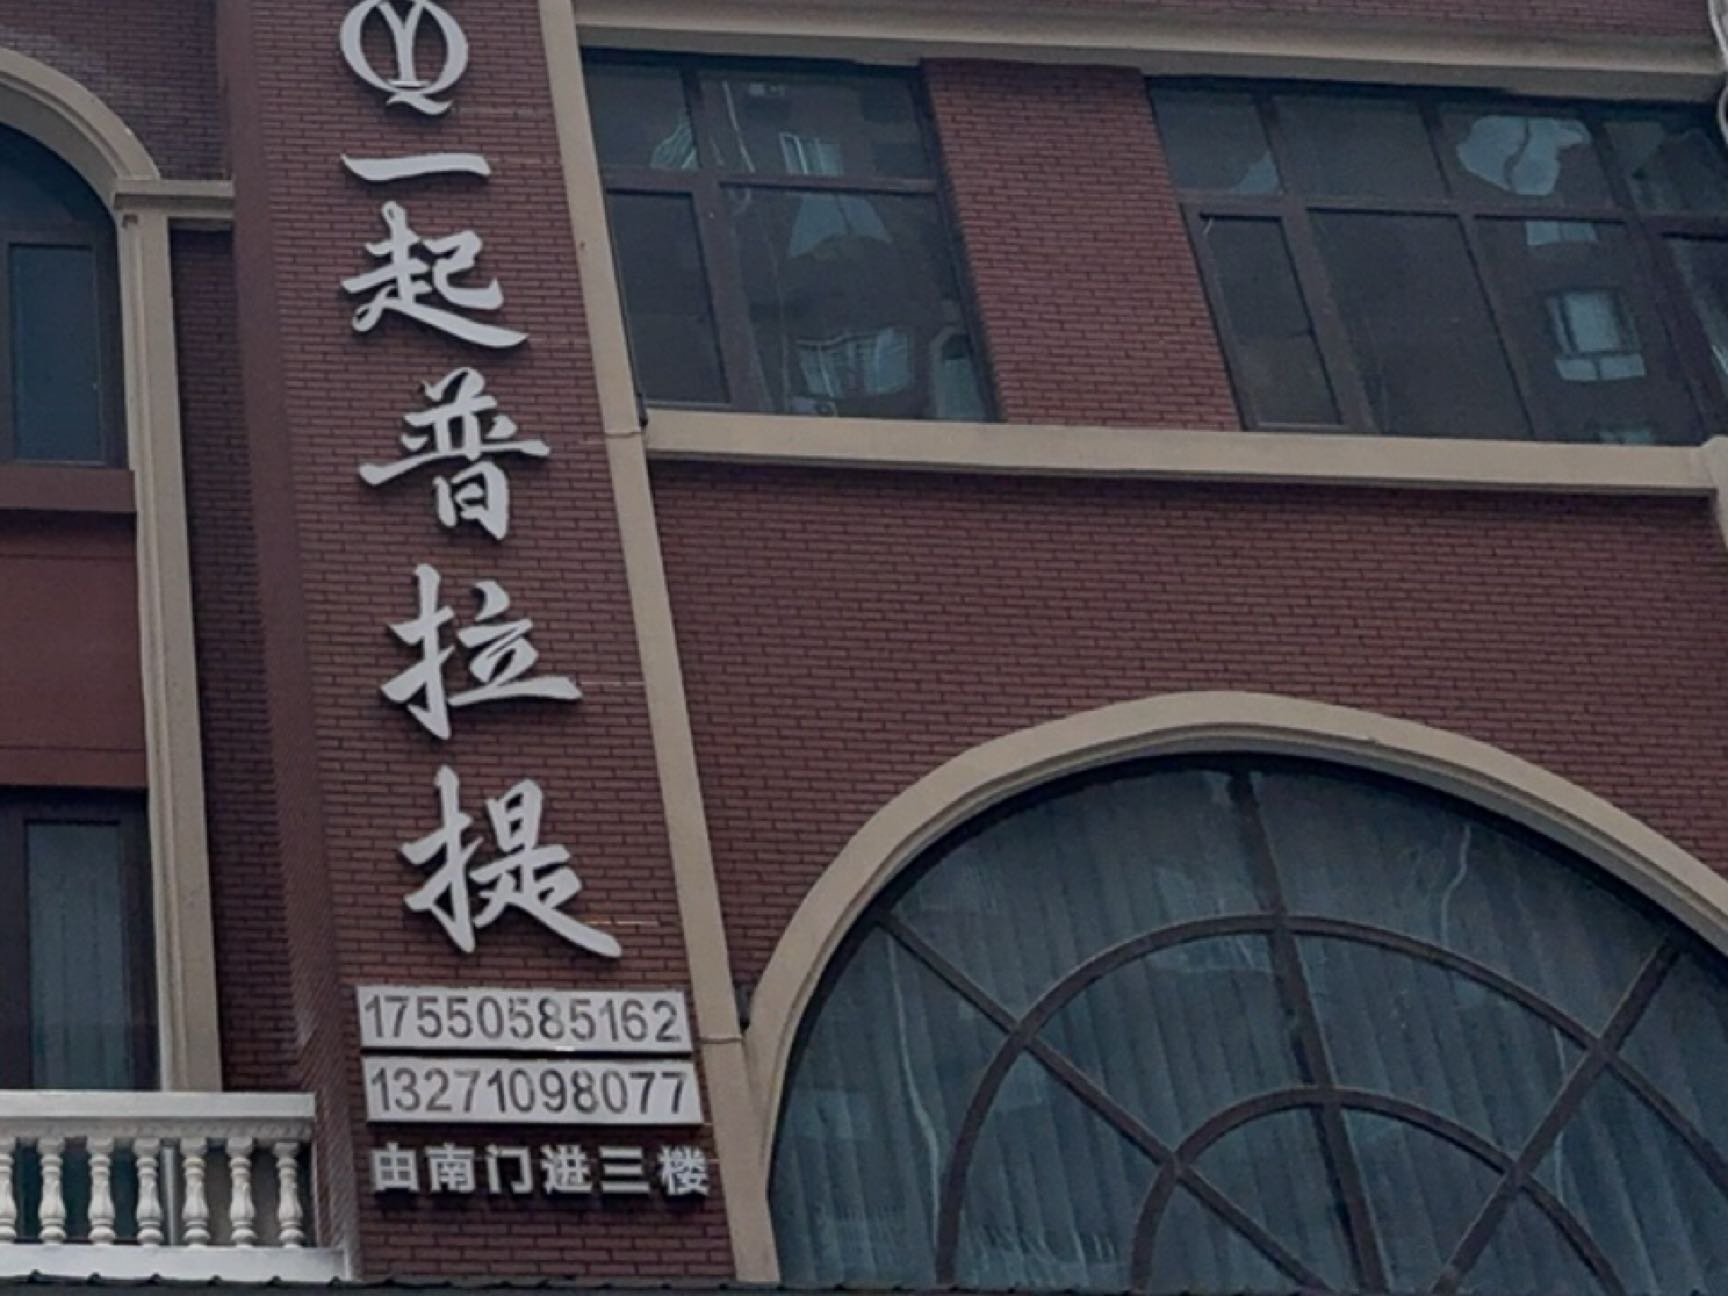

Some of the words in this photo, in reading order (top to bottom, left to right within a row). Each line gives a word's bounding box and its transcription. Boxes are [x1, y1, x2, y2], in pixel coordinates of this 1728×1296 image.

[341, 151, 623, 960] 一起普拉提
[365, 994, 682, 1043] 17550585162
[372, 1066, 688, 1116] 13271098077
[372, 1142, 709, 1196] 由南门进三楼
